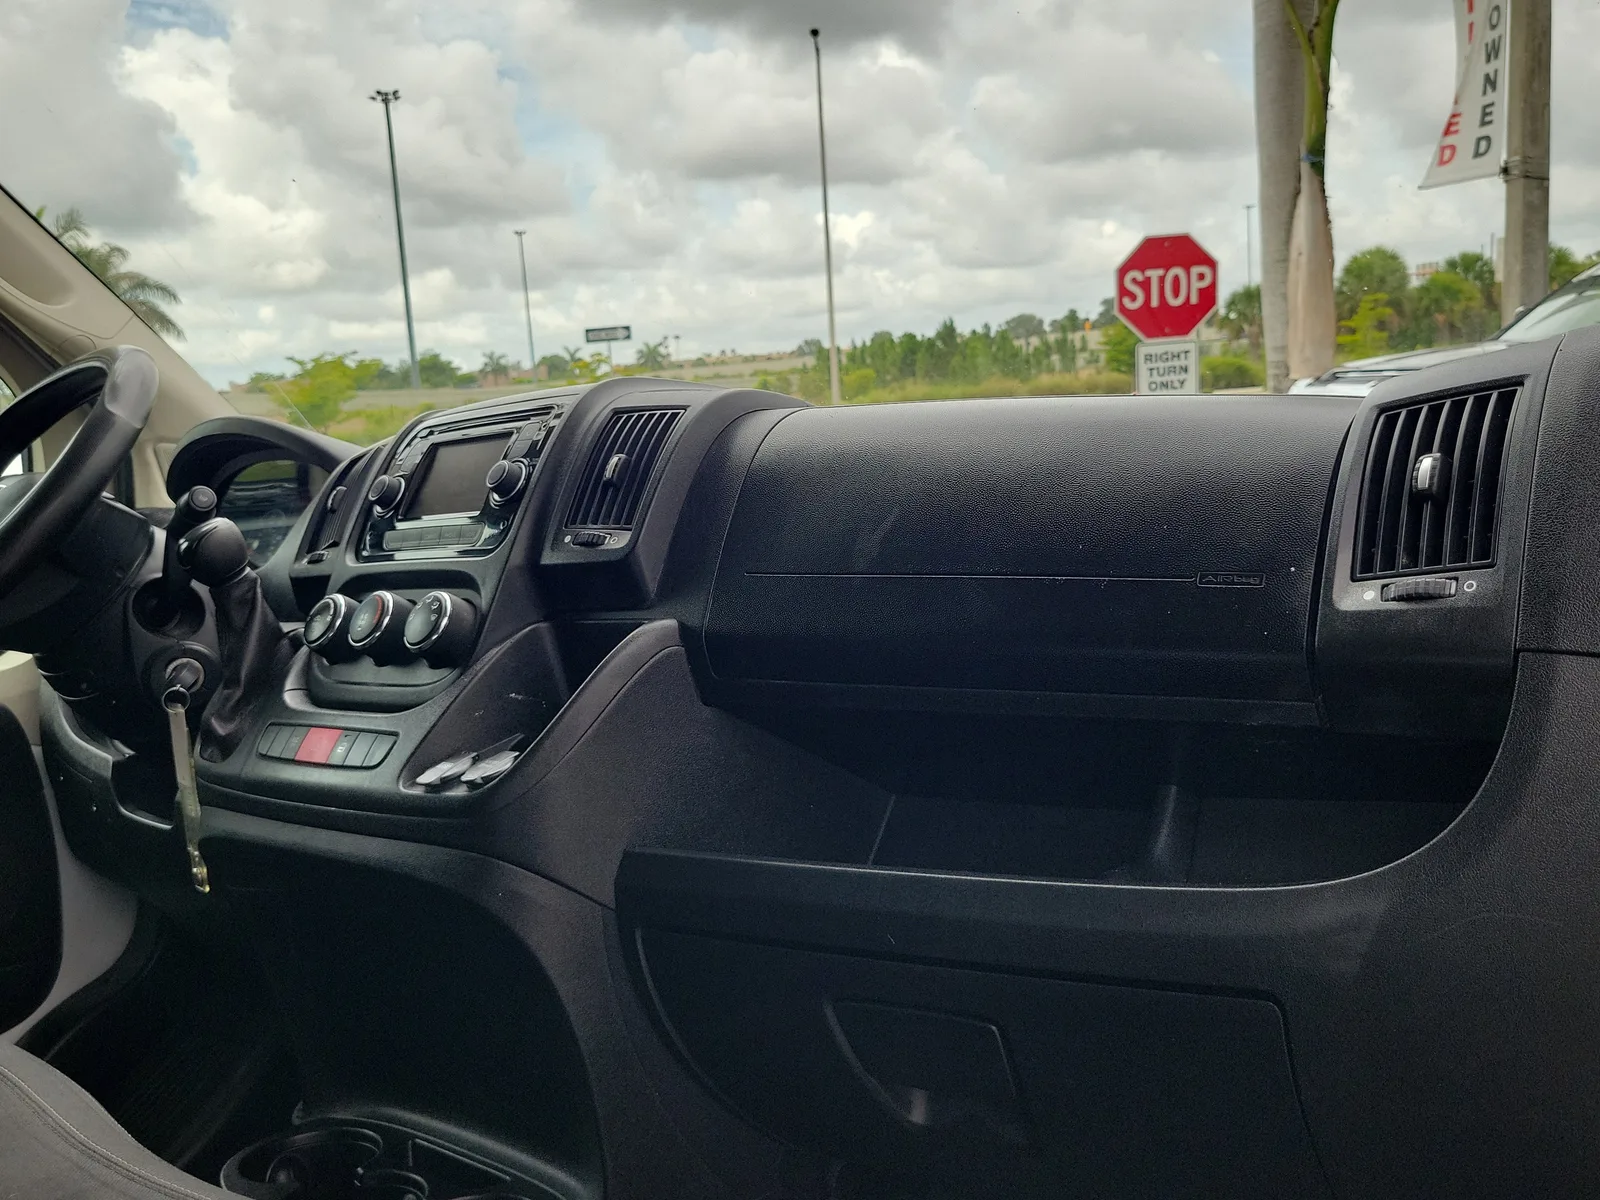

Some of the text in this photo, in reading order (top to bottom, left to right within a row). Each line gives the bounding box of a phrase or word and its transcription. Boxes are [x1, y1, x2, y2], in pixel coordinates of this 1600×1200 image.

[1472, 5, 1502, 159] OWNED
[1122, 265, 1213, 310] STOP
[1144, 350, 1190, 364] RIGHT
[1147, 365, 1188, 377] TURN
[1148, 379, 1186, 392] ONLY
